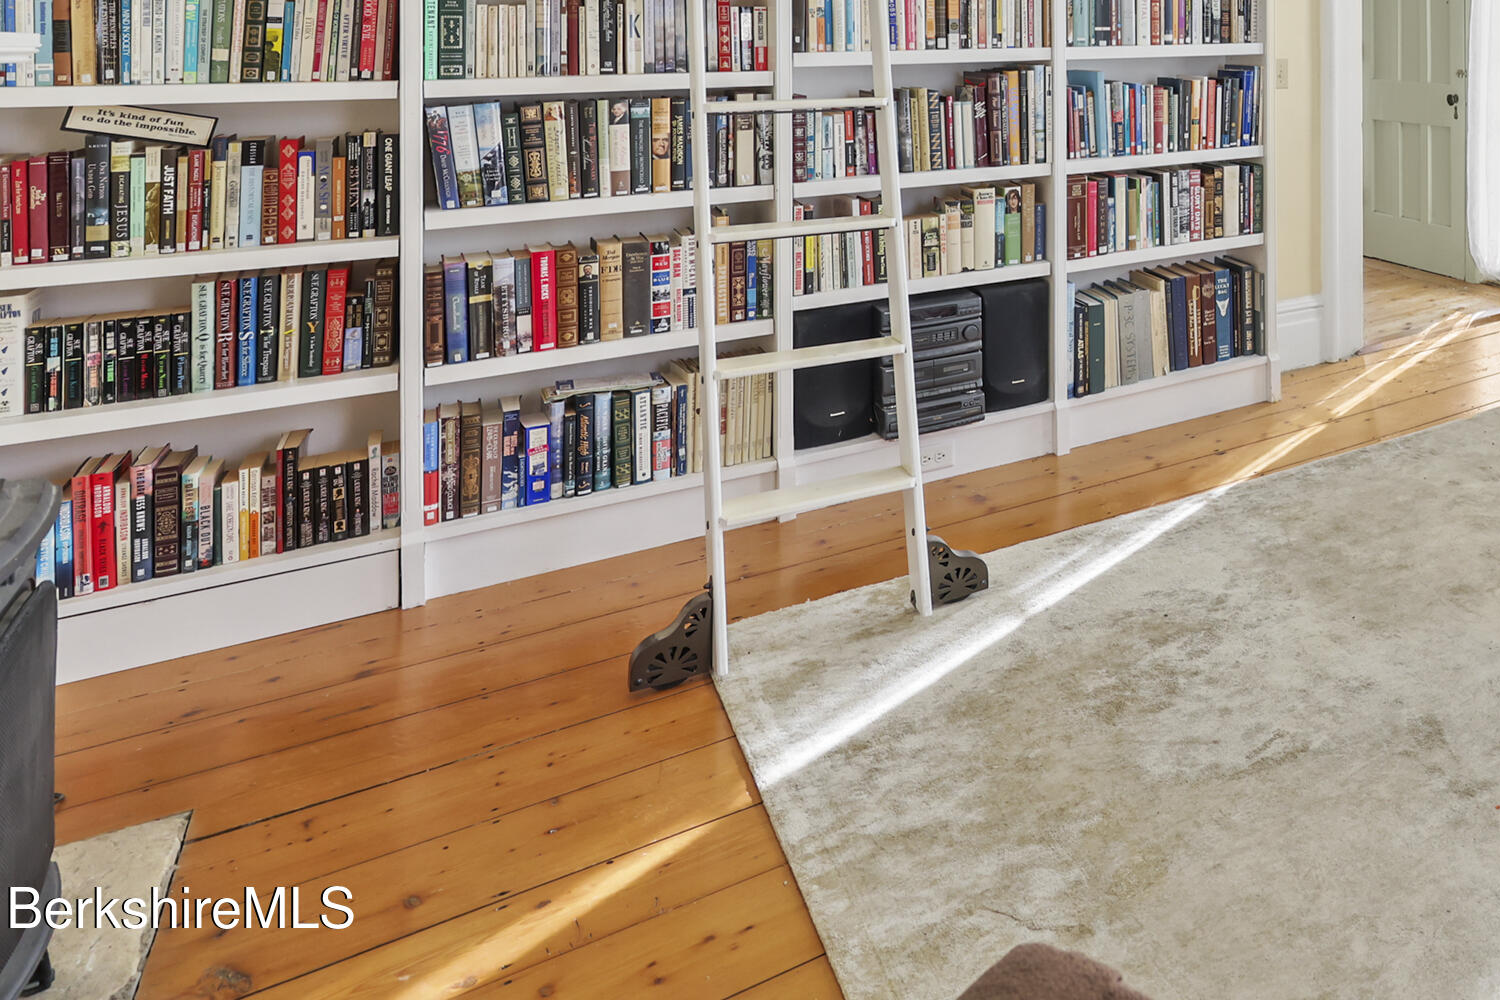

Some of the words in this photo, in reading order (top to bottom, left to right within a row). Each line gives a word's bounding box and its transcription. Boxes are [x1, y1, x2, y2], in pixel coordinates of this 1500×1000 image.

[428, 1, 436, 29] TENANT
[363, 24, 372, 40] EVIL
[97, 108, 115, 117] It's
[120, 112, 145, 122] kind
[149, 116, 160, 124] of
[164, 118, 184, 128] fun
[114, 119, 132, 128] the
[136, 122, 196, 136] impossible.
[676, 114, 684, 134] JAMES
[384, 138, 393, 152] ONE
[432, 129, 452, 154] 1776
[676, 135, 684, 164] MADISON
[88, 163, 96, 182] UNDER
[98, 161, 107, 174] ONE
[350, 165, 360, 178] 33
[384, 154, 393, 173] GIANT
[162, 164, 174, 187] JUST
[384, 174, 393, 191] LEAP
[88, 185, 96, 199] GOD
[98, 176, 107, 199] NATION
[350, 180, 360, 207] MEN
[162, 189, 174, 215] FAITH
[114, 204, 128, 238] JESUS
[672, 249, 681, 262] BAG
[540, 256, 550, 277] THOMAS
[672, 263, 681, 278] MAN
[758, 254, 772, 296] Mayflower
[199, 284, 208, 299] SUE
[220, 282, 230, 295] SUE
[242, 281, 252, 293] SUE
[262, 280, 272, 292] SUE
[540, 283, 550, 300] RICKS
[199, 301, 208, 332] GRAFTON
[220, 298, 230, 330] GRAFTON
[242, 295, 252, 330] GRAFTON
[262, 294, 272, 326] GRAFTON
[137, 324, 145, 350] GRAFTON
[218, 332, 233, 342] R
[239, 331, 254, 341] S
[260, 327, 275, 336] T
[28, 336, 36, 363] GRAFTON
[66, 333, 74, 356] GRAFTON
[242, 356, 252, 377] Silence
[260, 350, 272, 376] Trespass
[639, 396, 648, 430] ATLANTIC
[656, 403, 670, 431] PACIFIC
[579, 414, 589, 440] Atlantic
[579, 440, 589, 456] High
[371, 468, 380, 486] Rachel
[74, 490, 86, 523] OUTRAGE
[371, 489, 380, 517] Maddow
[136, 511, 146, 532] KNOWS
[200, 506, 211, 530] BLACK
[200, 532, 211, 546] OUT
